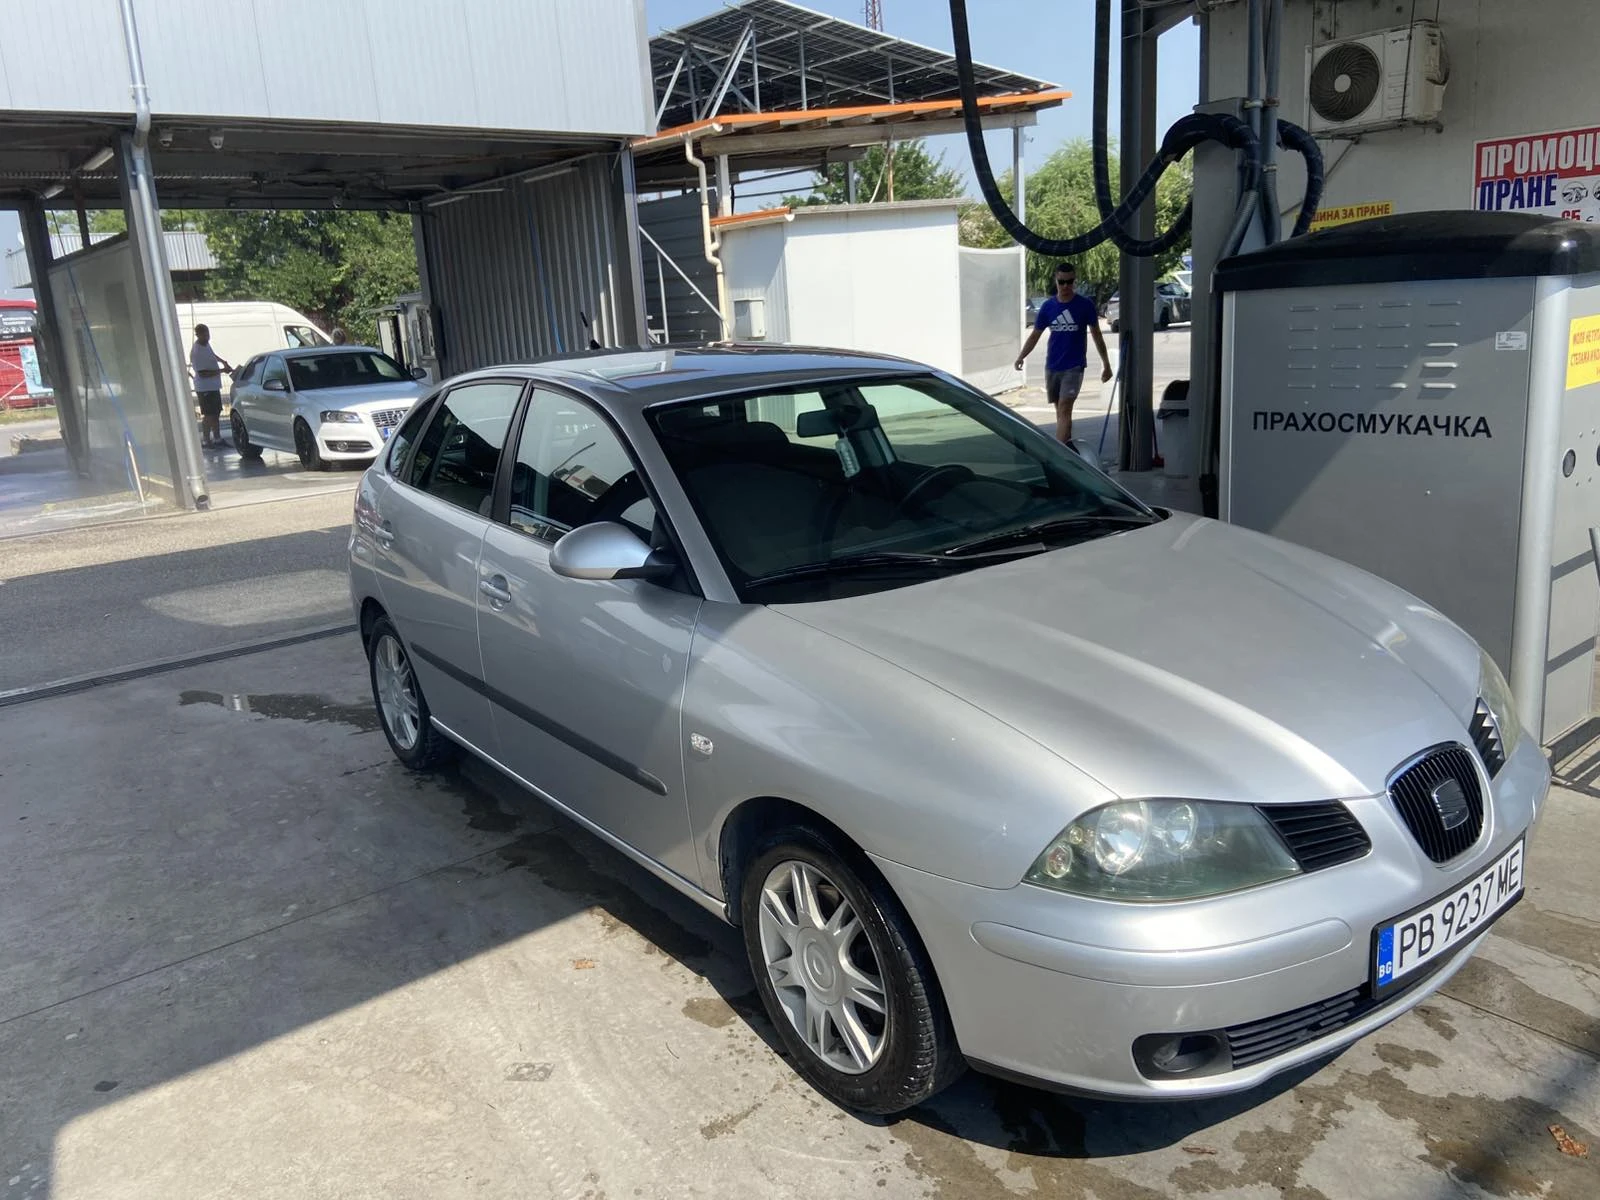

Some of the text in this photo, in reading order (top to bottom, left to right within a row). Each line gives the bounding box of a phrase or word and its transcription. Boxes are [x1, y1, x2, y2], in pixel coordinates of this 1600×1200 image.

[1480, 174, 1558, 211] ПРАНЕ
[1342, 206, 1355, 219] ЗА
[1357, 203, 1390, 217] ПРАНЕ
[1049, 323, 1079, 331] adidas
[1253, 411, 1493, 438] ПРАХОСМУКАЧКА
[1399, 849, 1520, 968] PB 9237 ME
[1379, 961, 1392, 978] BG
